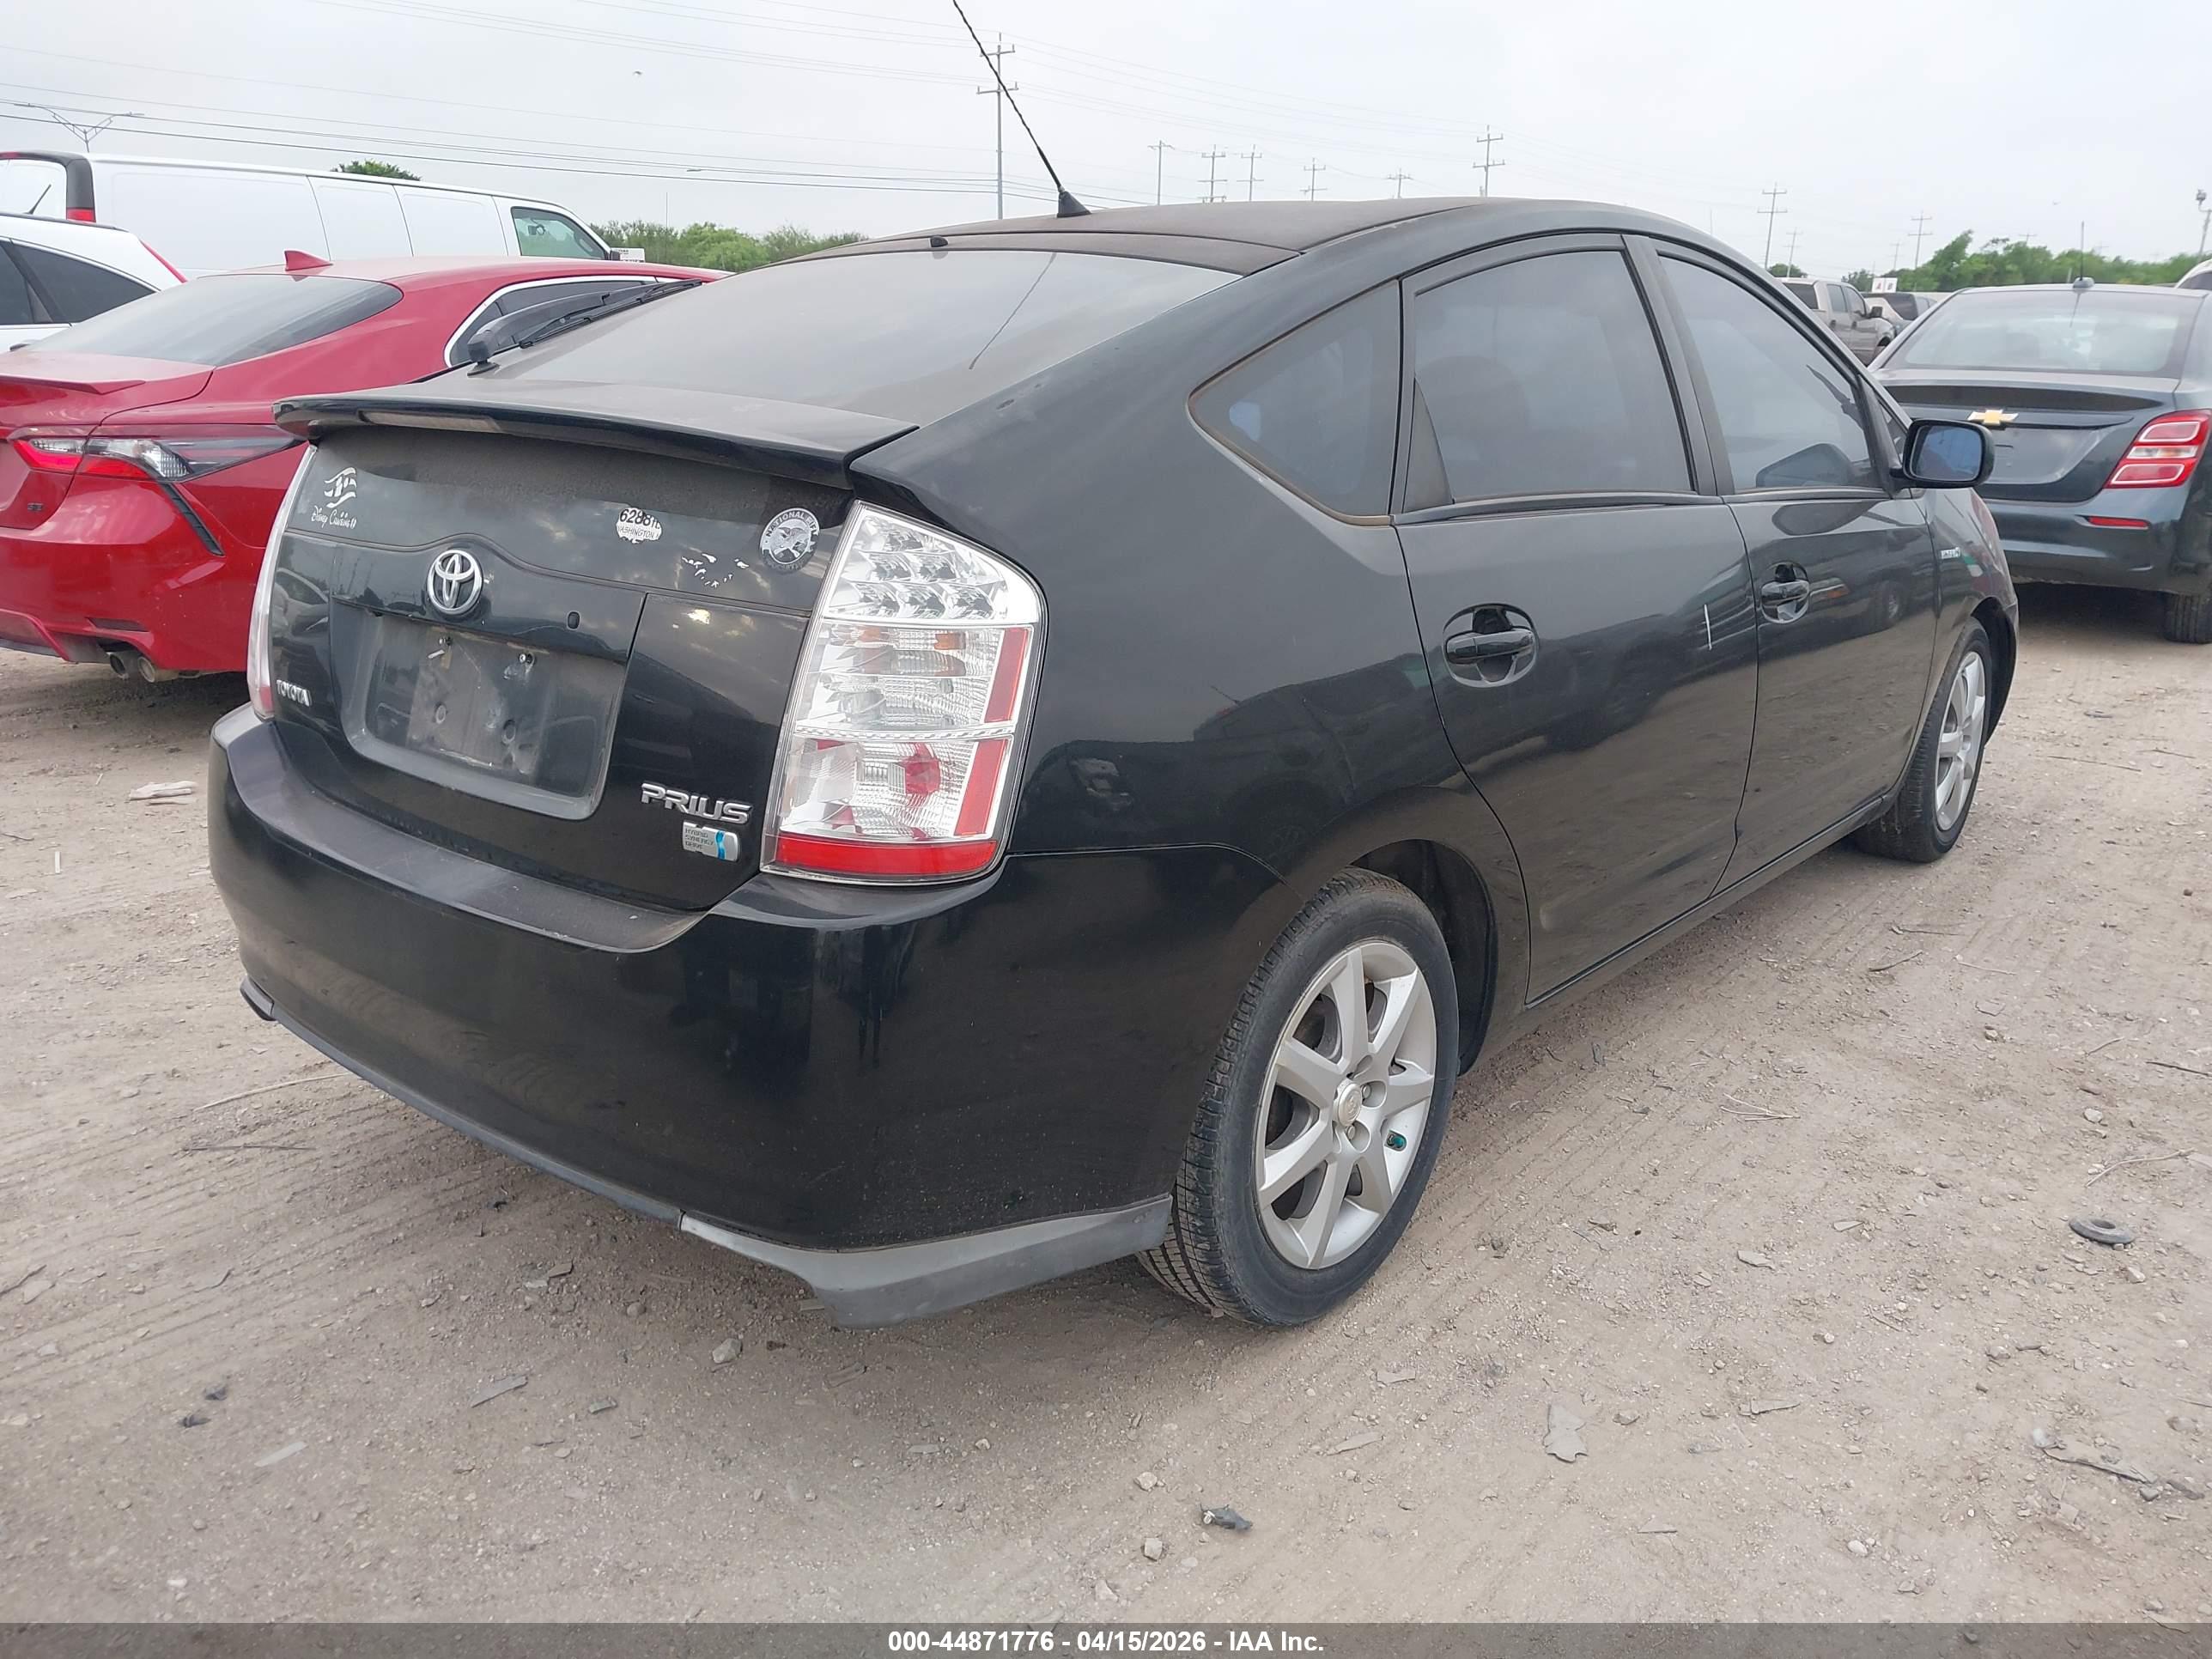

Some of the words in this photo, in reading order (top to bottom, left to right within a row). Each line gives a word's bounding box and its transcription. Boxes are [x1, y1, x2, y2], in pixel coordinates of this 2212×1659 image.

[765, 510, 805, 538] NATIONAL
[276, 678, 311, 708] TOYOTA
[641, 782, 754, 824] PRIUS
